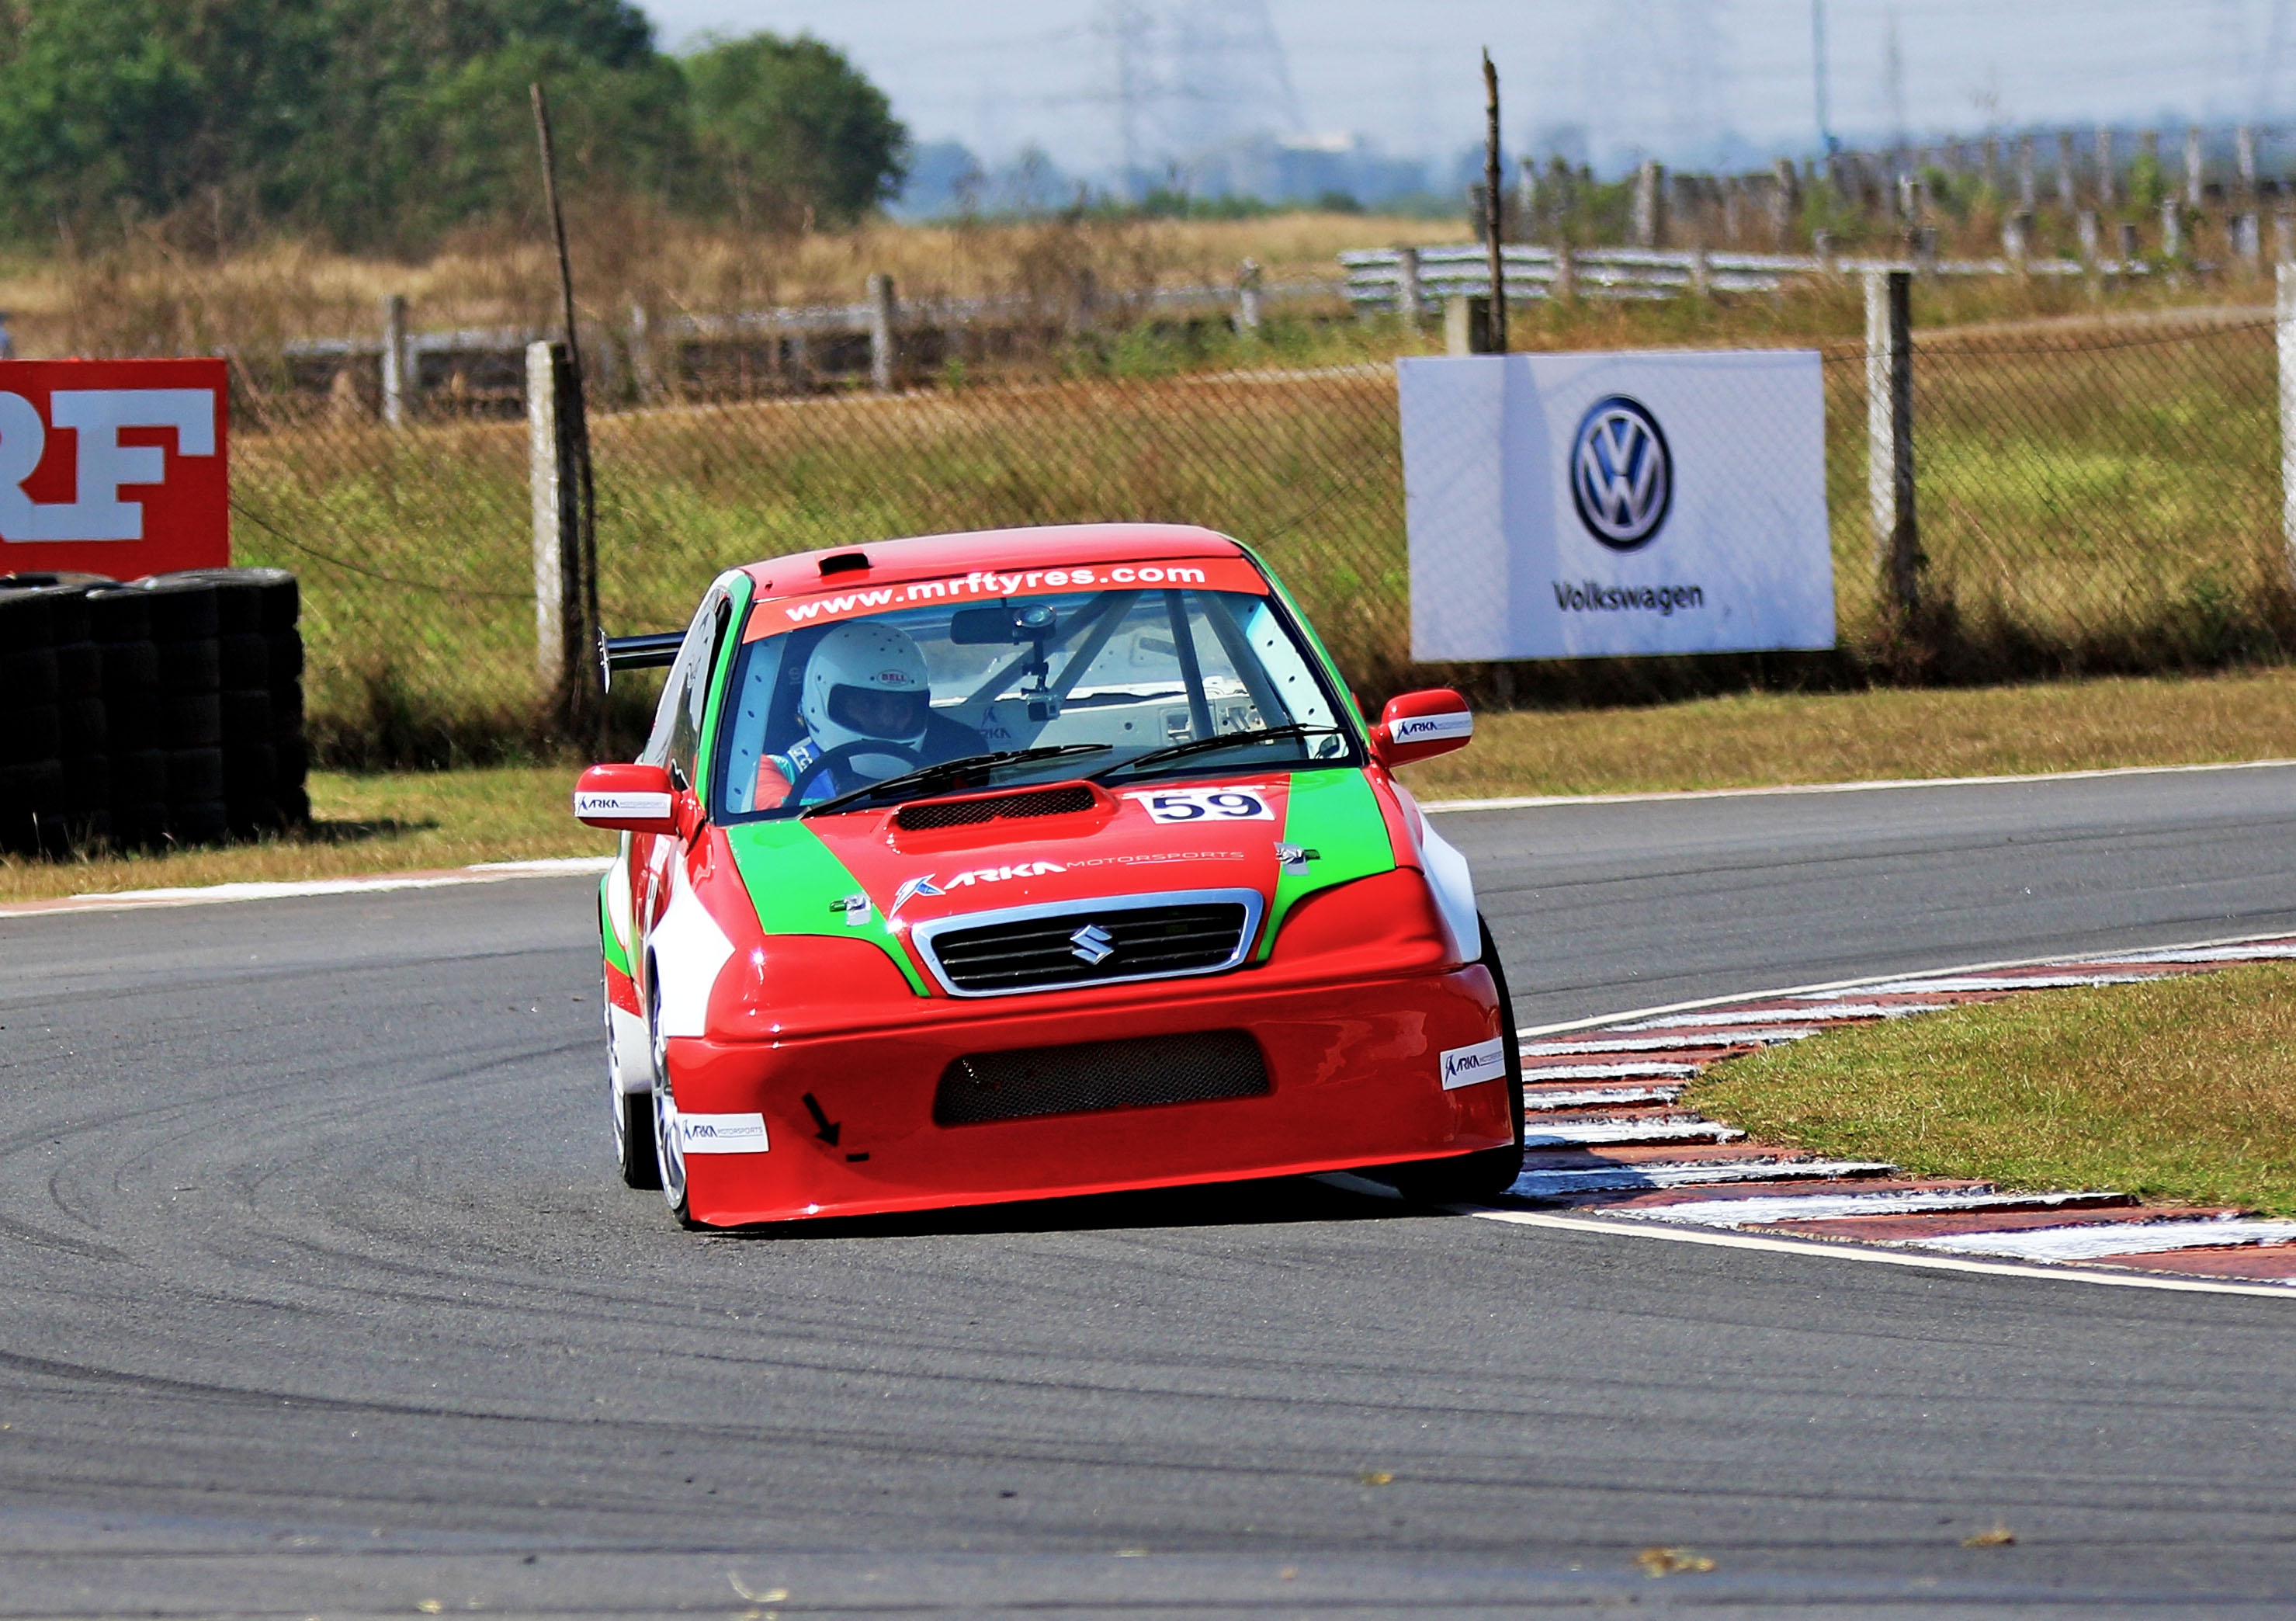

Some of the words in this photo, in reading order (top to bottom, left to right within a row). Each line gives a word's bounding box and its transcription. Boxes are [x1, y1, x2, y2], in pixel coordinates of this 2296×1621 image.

[786, 564, 1205, 622] www.mrftyres.com
[1553, 582, 1704, 616] Volkswagen
[882, 673, 907, 682] BELL
[1410, 721, 1438, 733] ARKA
[588, 799, 619, 808] ARKA
[1153, 793, 1262, 820] 59
[944, 861, 1067, 890] ARKA
[1067, 851, 1244, 867] MOTORSPORTS
[1456, 1054, 1481, 1072] ARKA
[692, 1125, 718, 1137] ARKA
